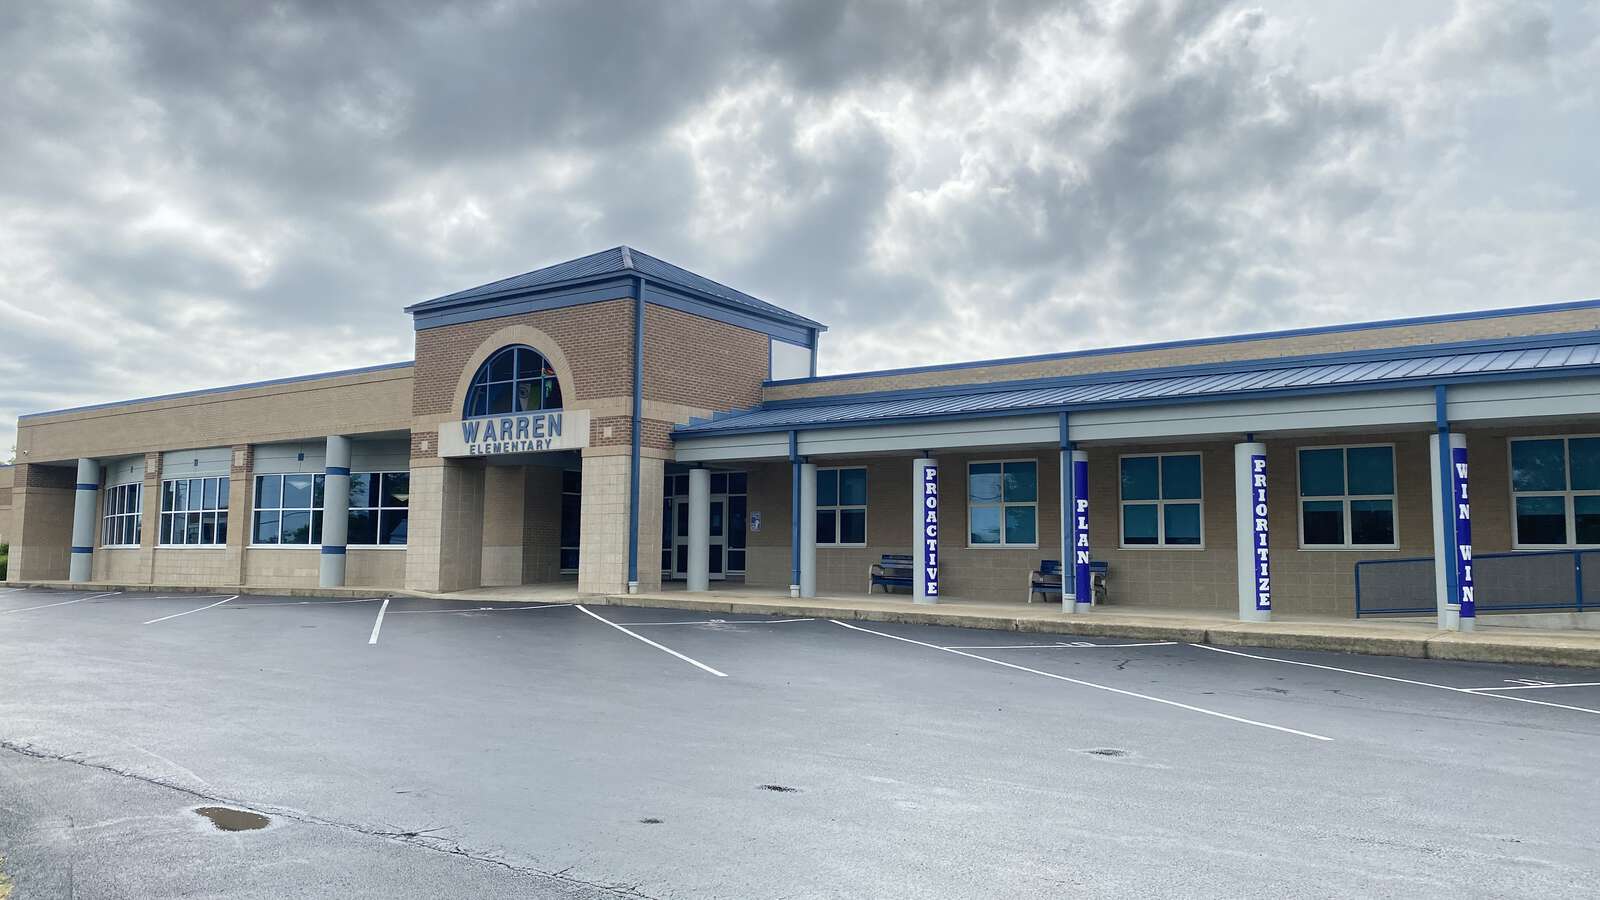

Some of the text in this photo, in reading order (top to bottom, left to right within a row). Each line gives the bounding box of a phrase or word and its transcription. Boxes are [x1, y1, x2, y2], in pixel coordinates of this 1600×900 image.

[462, 413, 562, 443] WARREN
[470, 438, 552, 455] ELEMENTARY
[925, 468, 937, 594] PROACTIVE
[1076, 499, 1089, 564] PLAN
[1254, 459, 1271, 606] PRIORITIZE
[1455, 463, 1474, 602] WIN WIN
